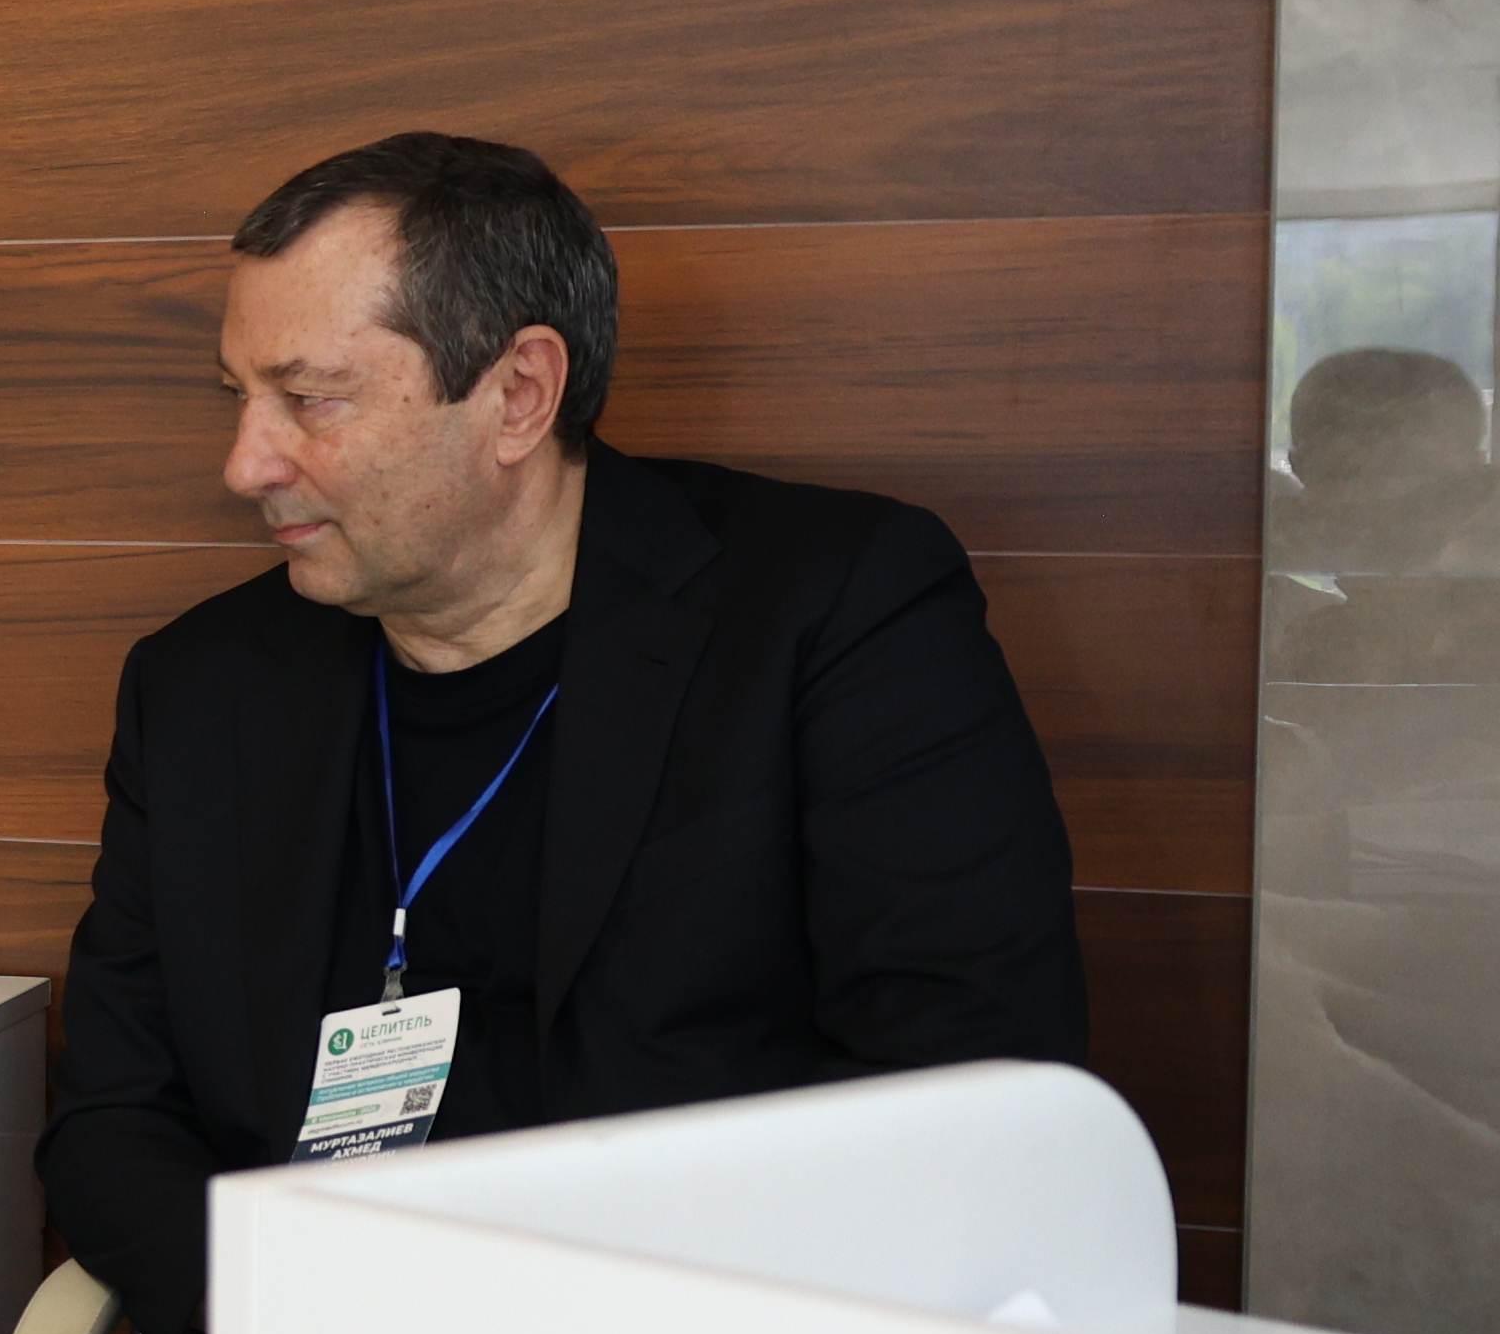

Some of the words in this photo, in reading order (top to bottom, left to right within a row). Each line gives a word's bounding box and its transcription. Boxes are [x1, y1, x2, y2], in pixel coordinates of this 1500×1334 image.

[360, 1015, 433, 1040] ЦЕЛИТЕЛЬ
[310, 1122, 415, 1154] МУРТАЗАЛИЕВ
[331, 1140, 383, 1160] АХМЕД
